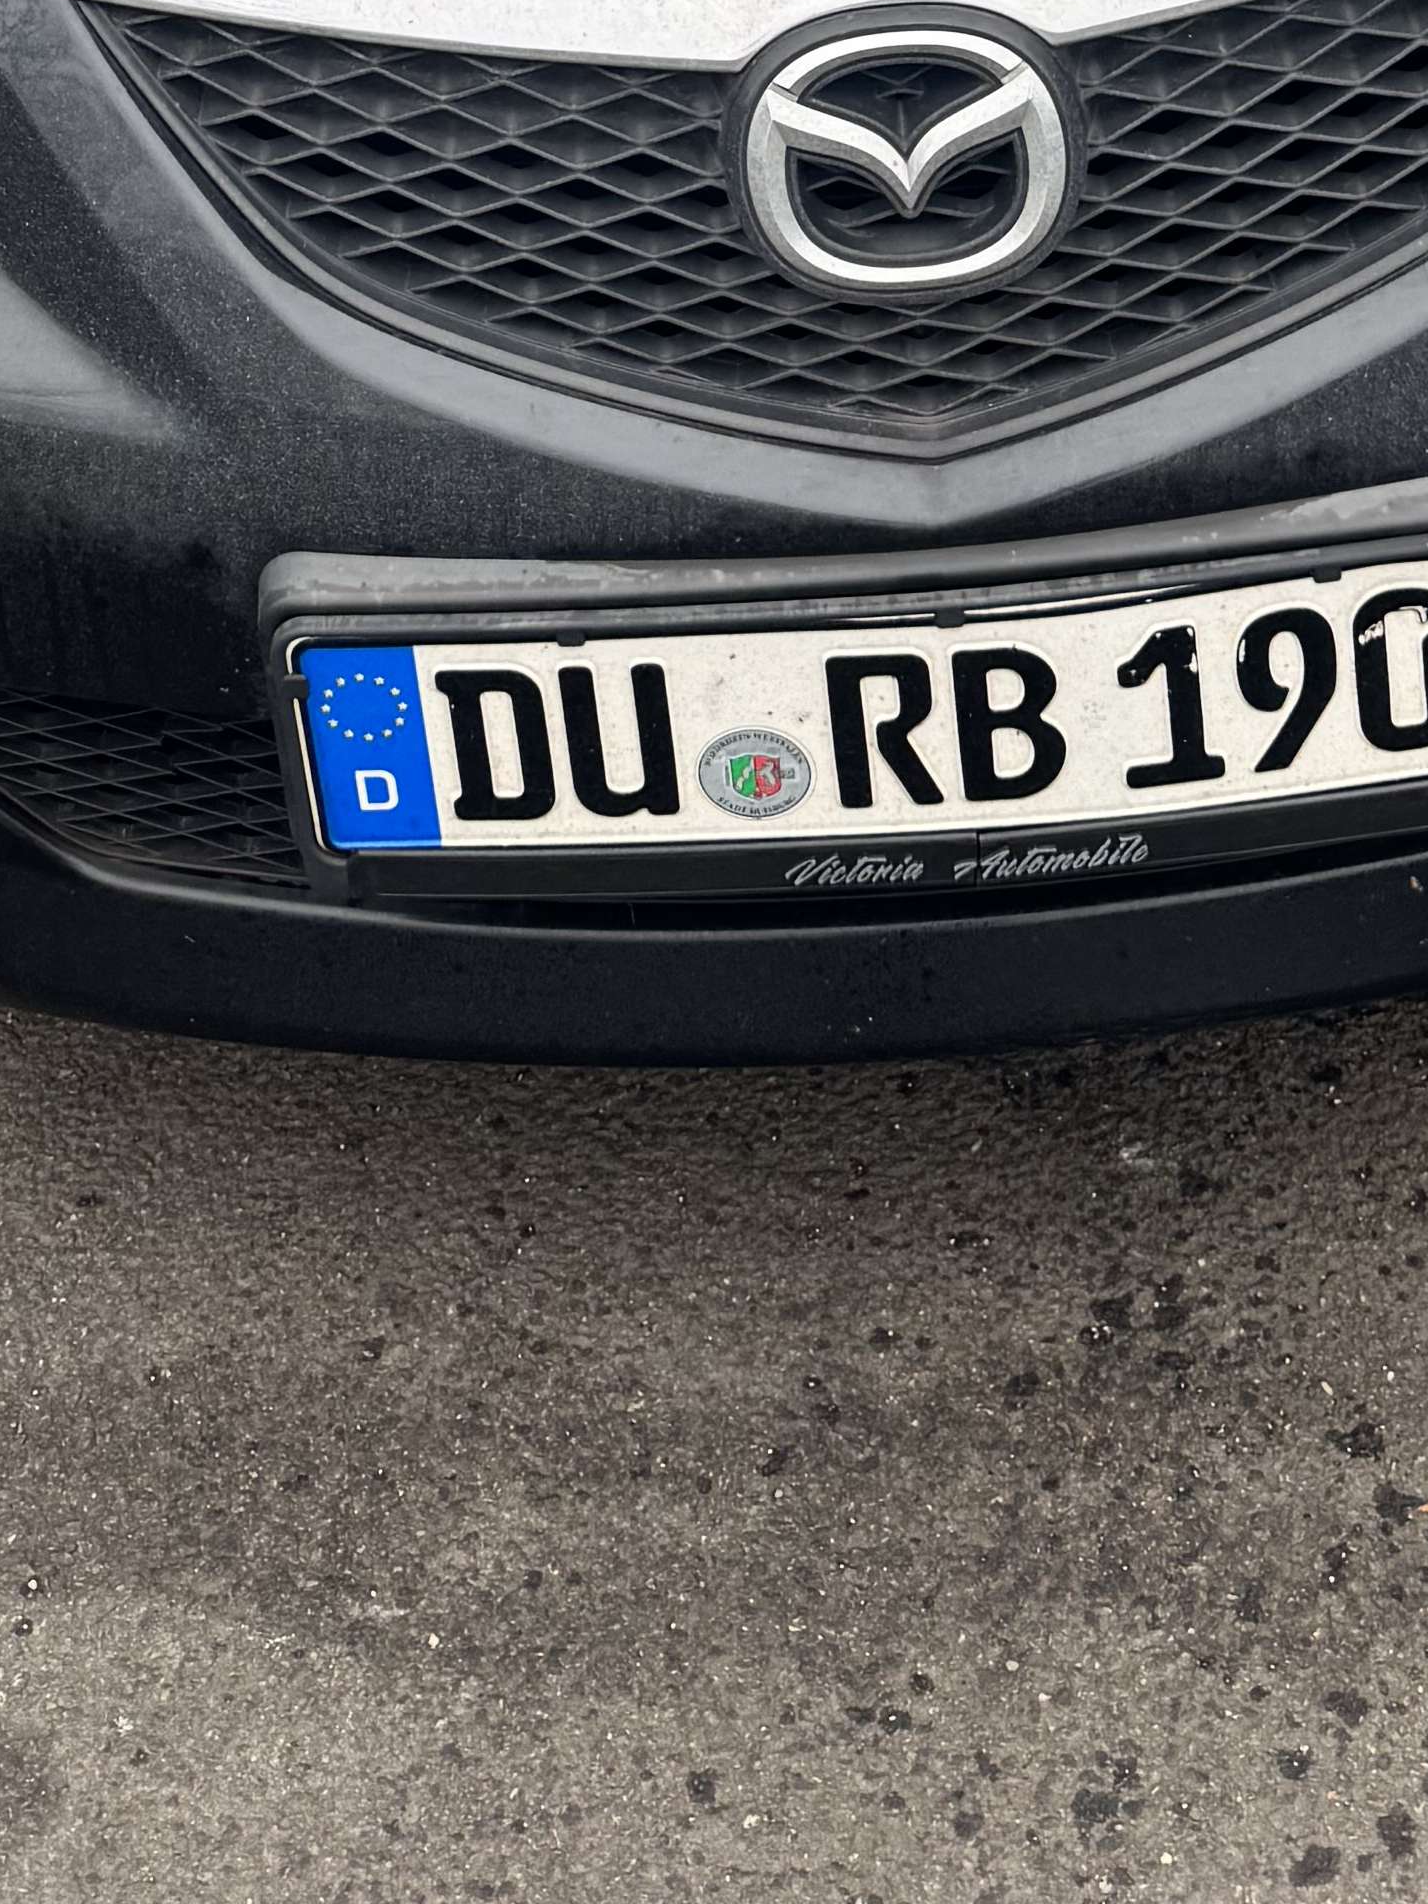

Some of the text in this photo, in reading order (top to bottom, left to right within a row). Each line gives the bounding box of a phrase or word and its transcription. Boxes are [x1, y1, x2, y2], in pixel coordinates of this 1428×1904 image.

[434, 663, 680, 821] DU
[824, 646, 1067, 808] RB
[354, 769, 400, 812] D
[784, 833, 1150, 887] Victoria Automobile
